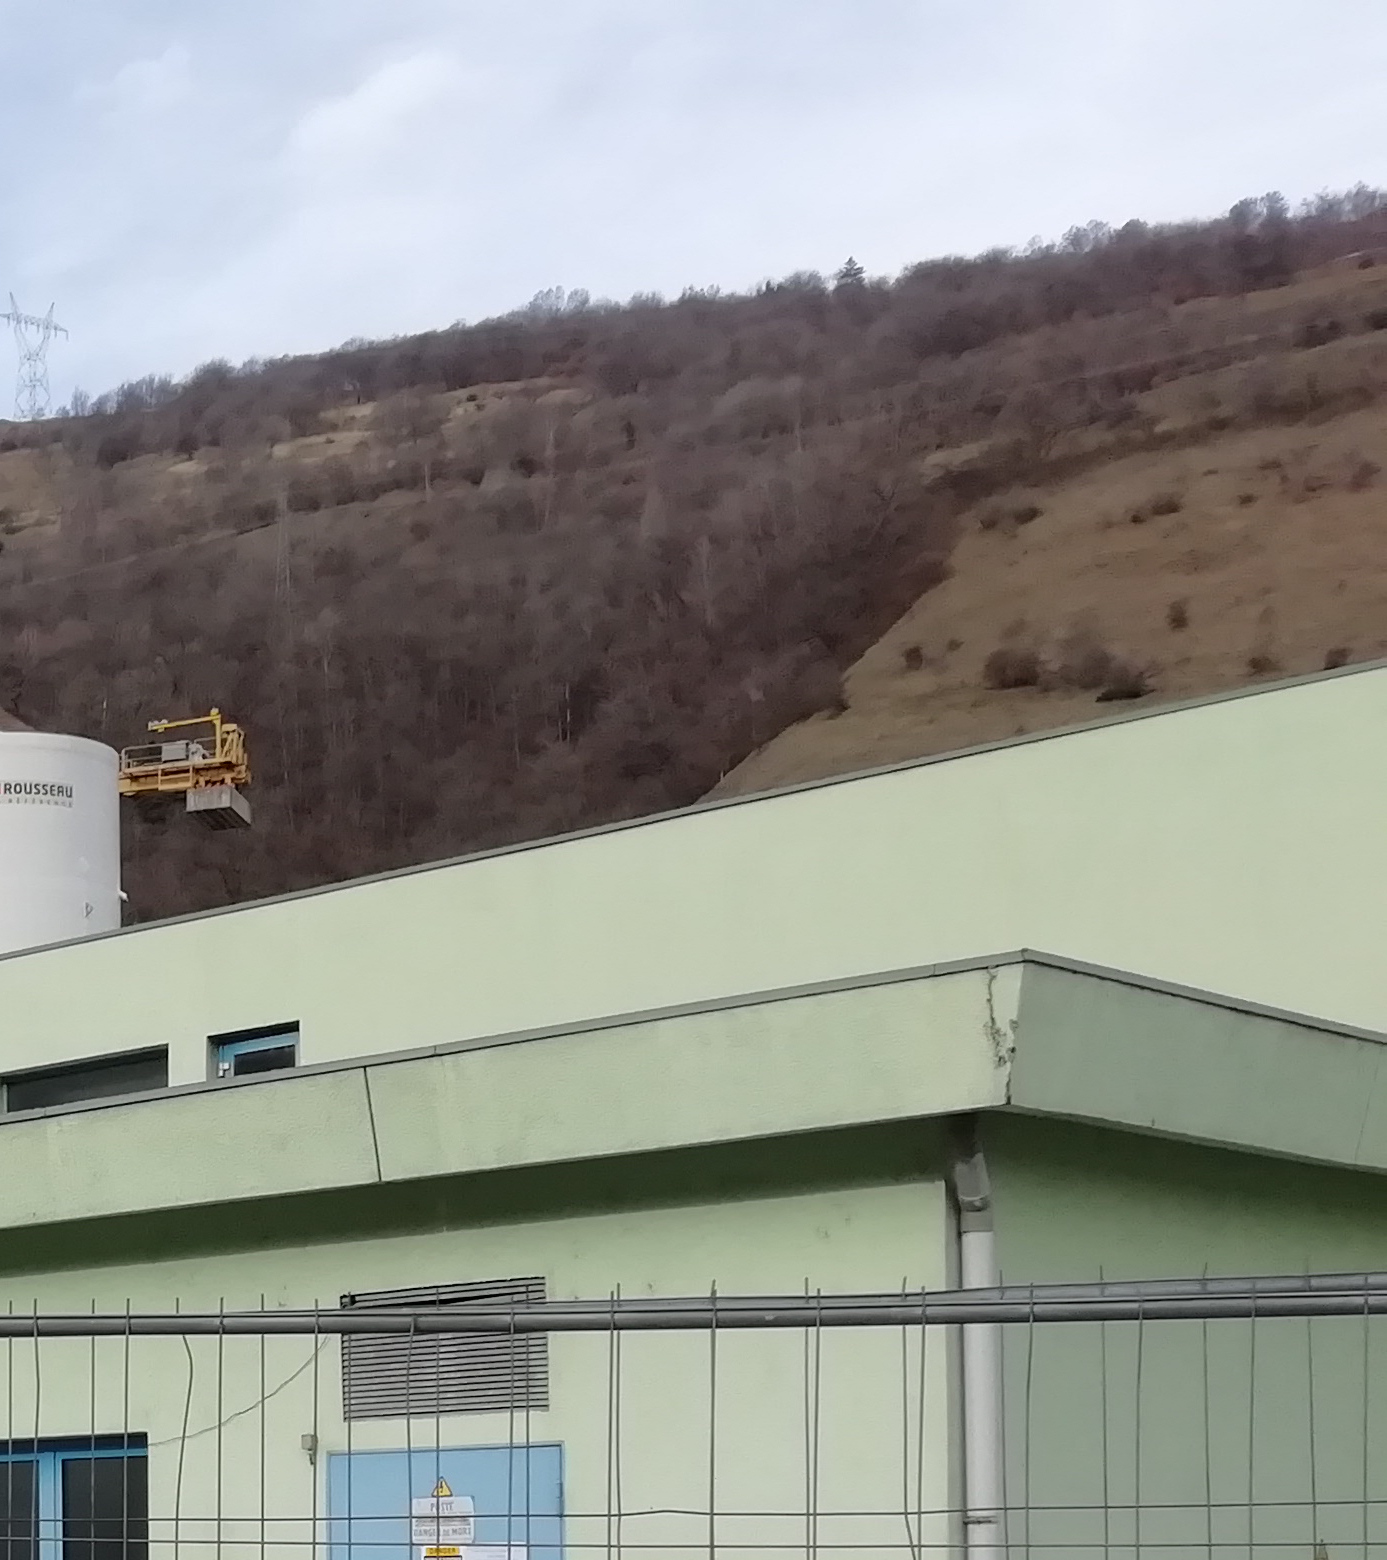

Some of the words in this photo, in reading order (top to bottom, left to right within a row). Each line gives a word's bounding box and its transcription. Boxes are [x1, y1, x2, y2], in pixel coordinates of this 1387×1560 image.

[3, 782, 73, 798] ROUSSEAU
[429, 1502, 455, 1511] PSTE
[414, 1528, 440, 1537] DANGE
